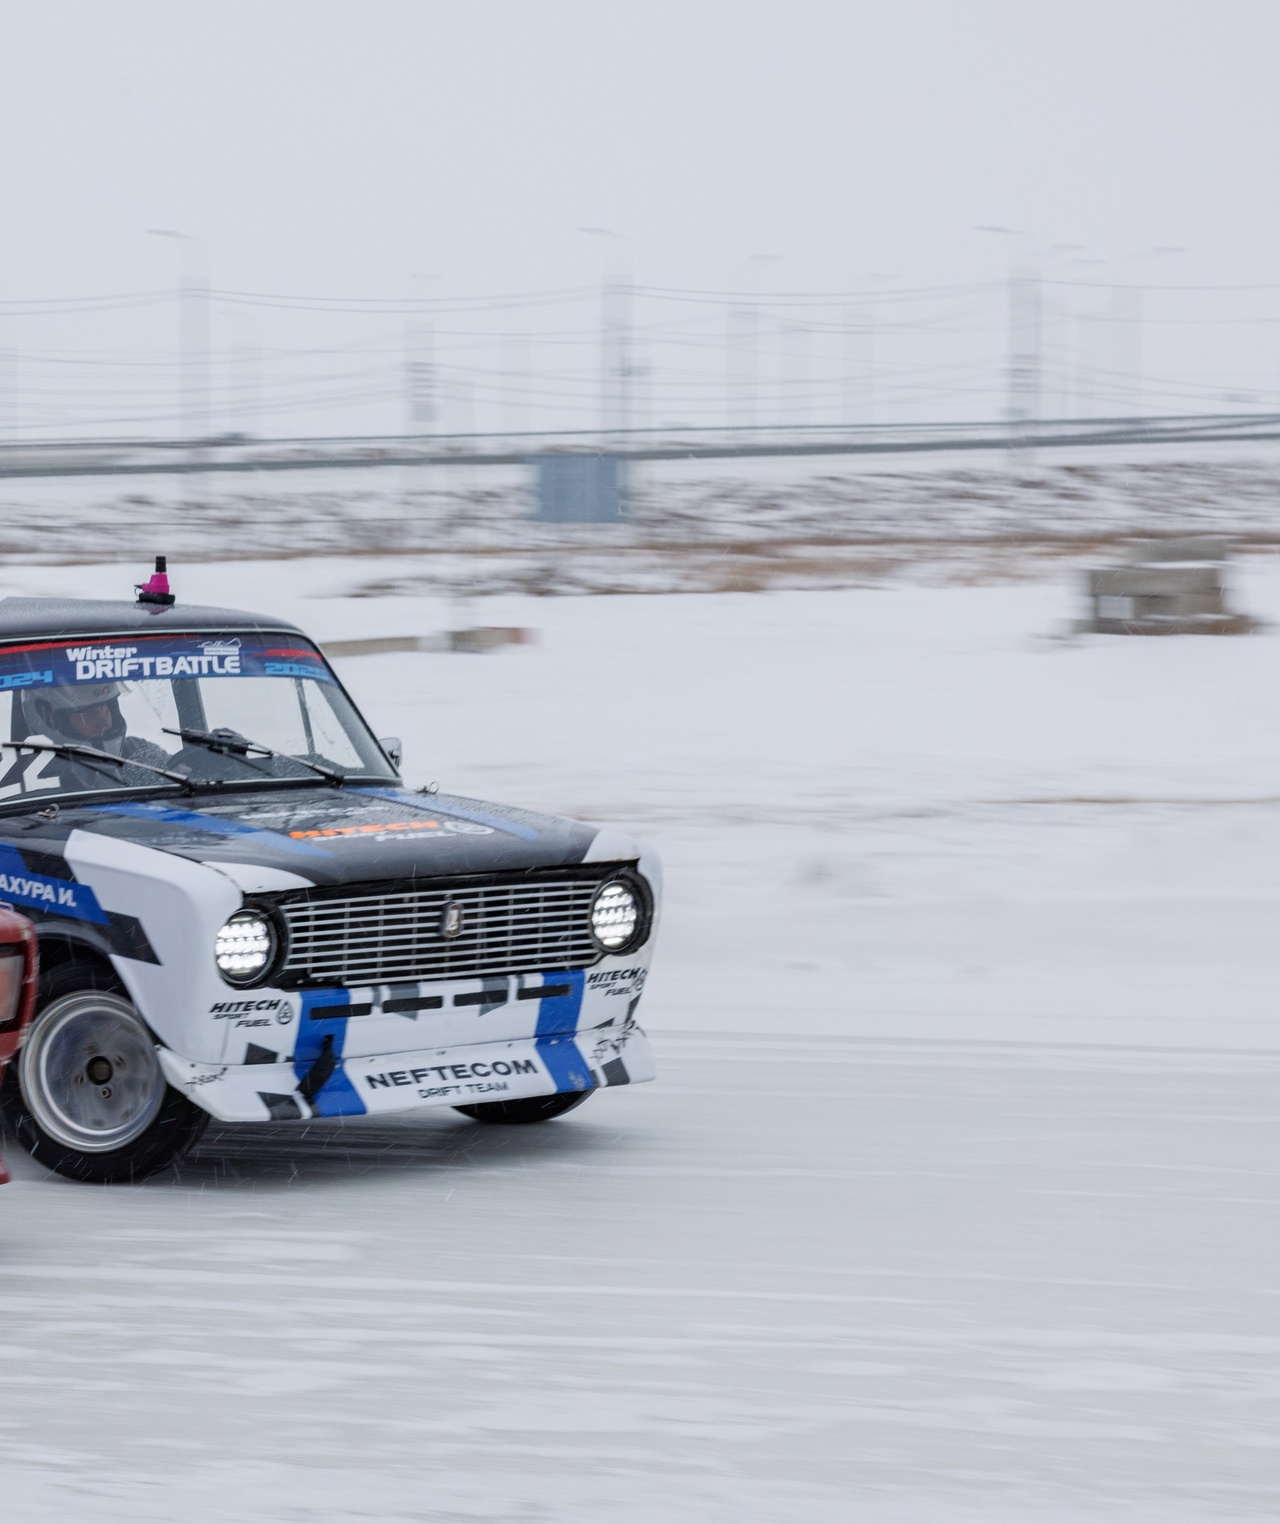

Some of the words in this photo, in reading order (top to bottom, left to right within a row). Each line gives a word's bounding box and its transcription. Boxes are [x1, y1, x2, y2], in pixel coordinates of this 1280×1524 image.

[66, 645, 138, 662] Winter
[76, 655, 241, 680] DRIFTBATTLE
[58, 887, 77, 907] И.
[586, 967, 641, 984] HITECH
[605, 987, 631, 997] FUEL
[209, 999, 282, 1013] HITECH
[235, 1019, 272, 1028] FUEL
[365, 1059, 538, 1089] NEFTECOM
[417, 1085, 462, 1099] DRIFT
[465, 1081, 510, 1094] TEAM
